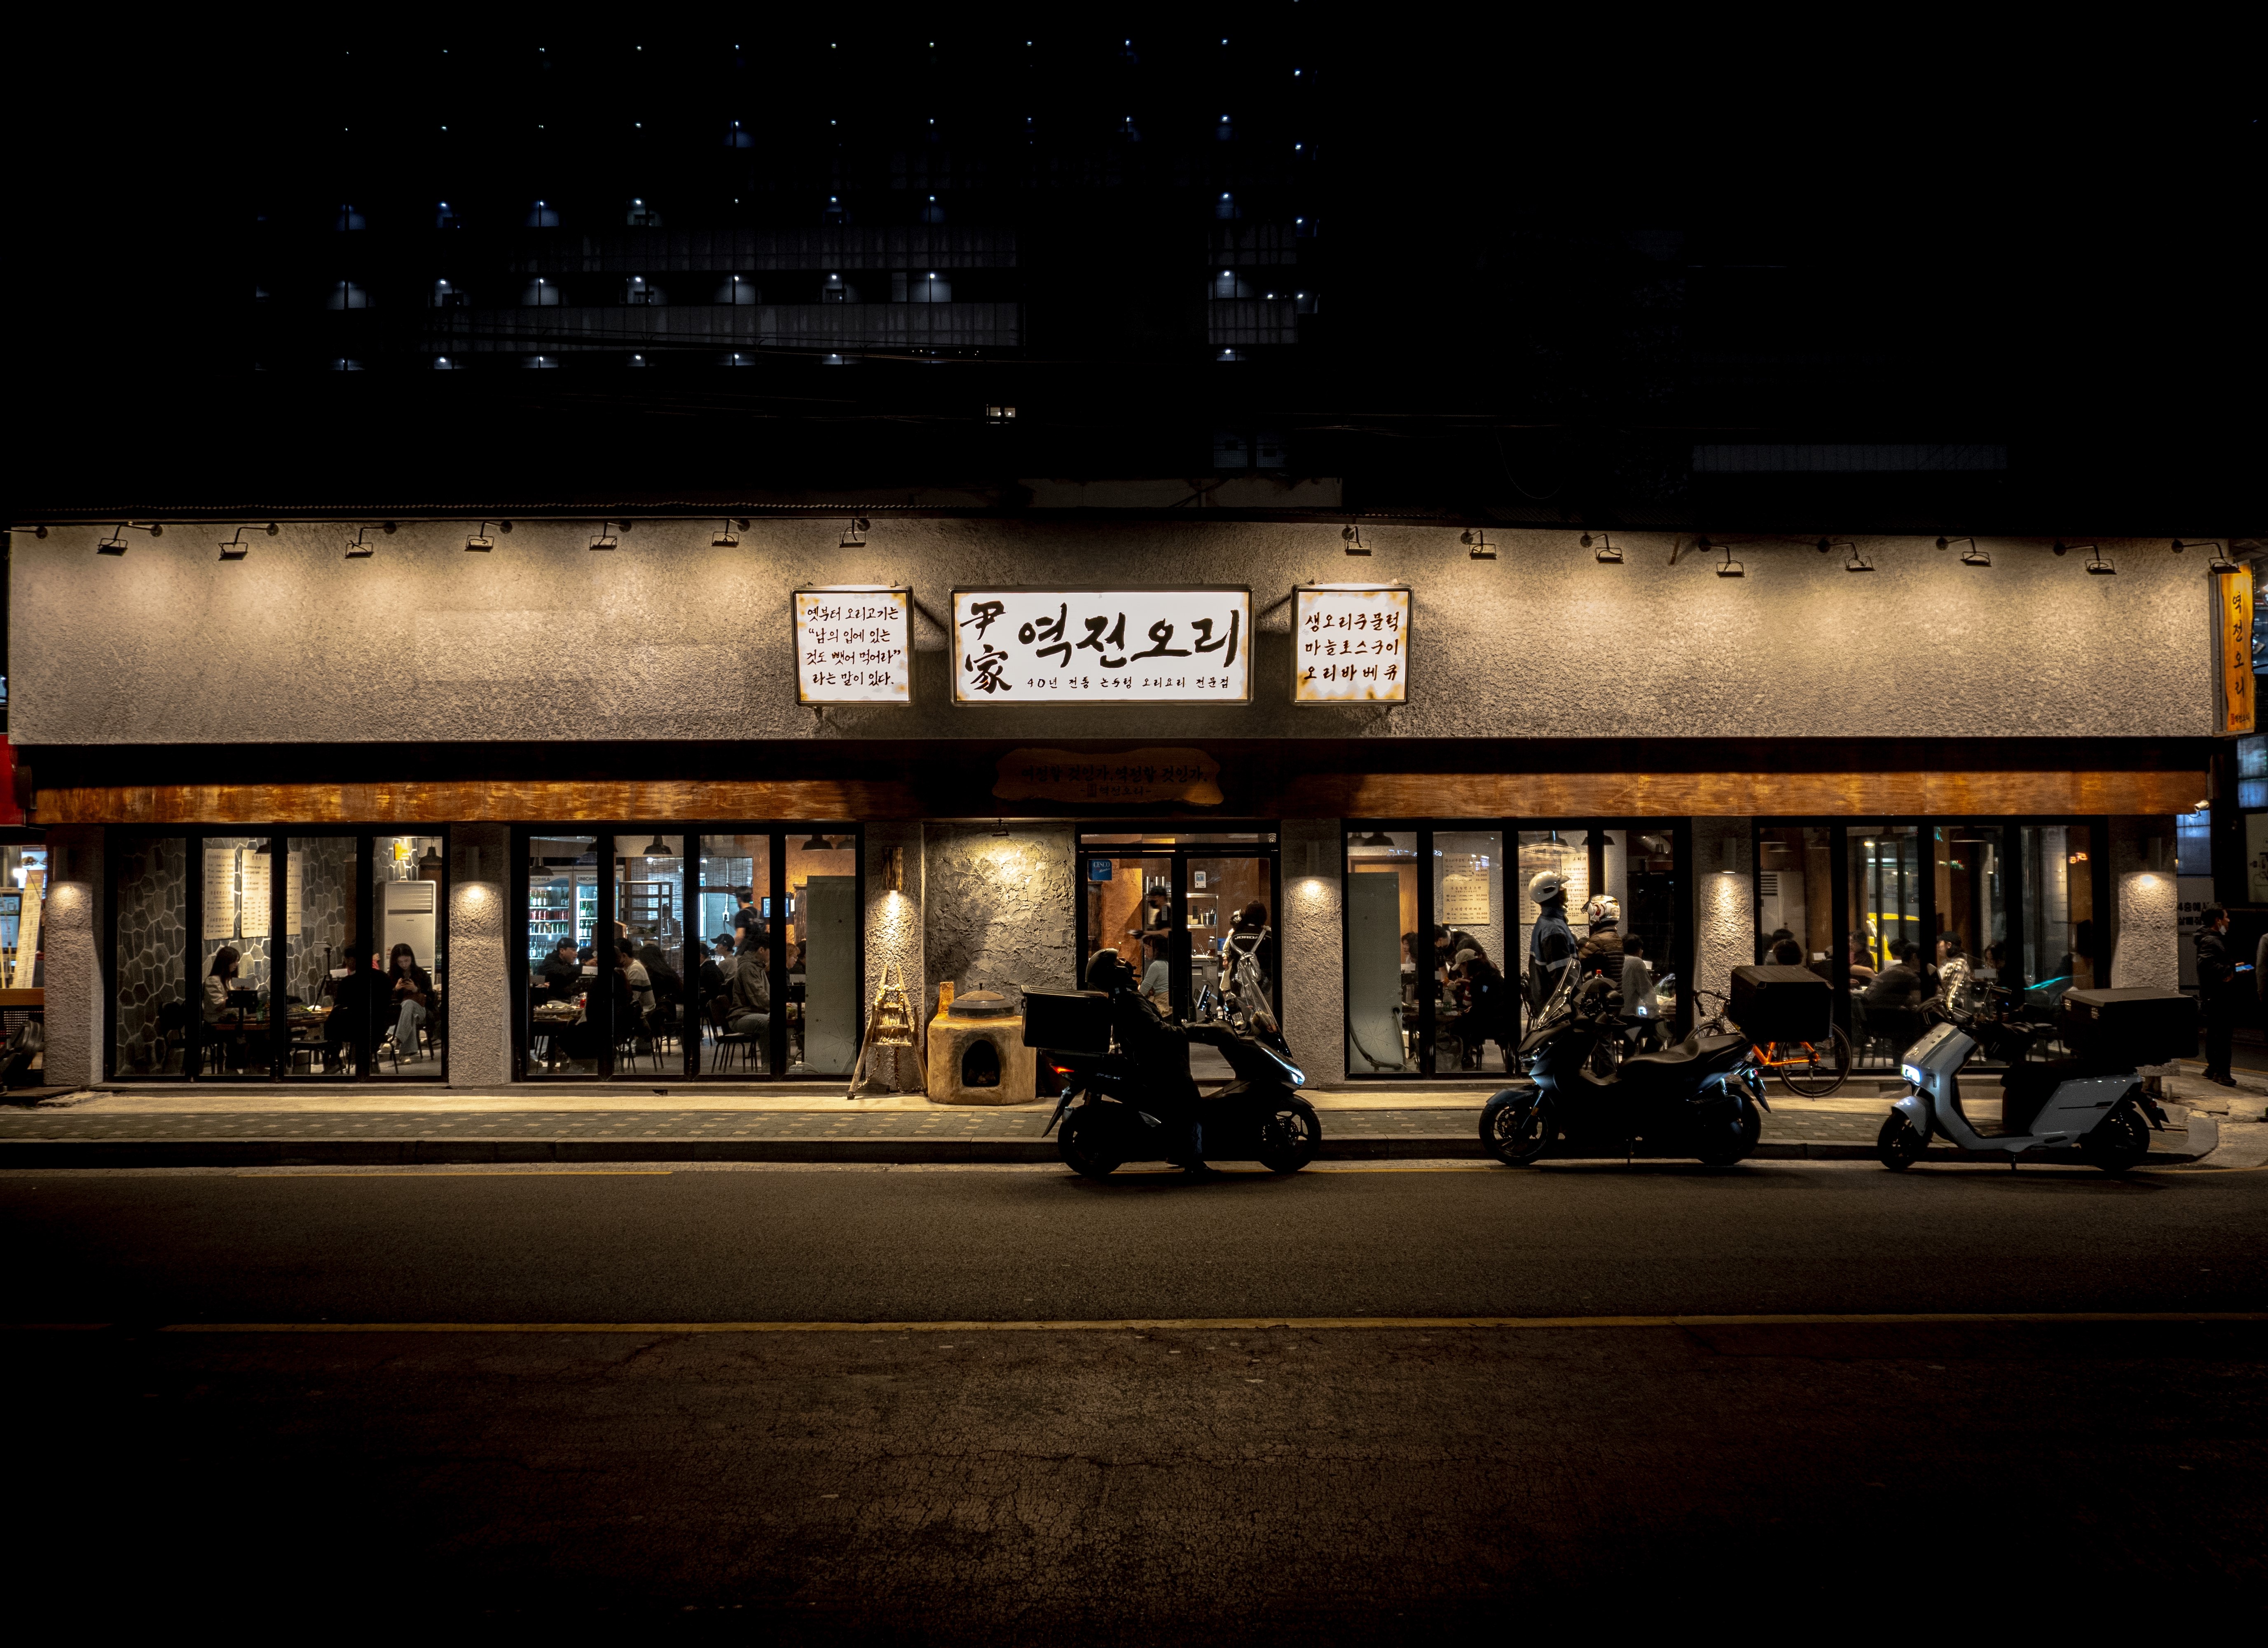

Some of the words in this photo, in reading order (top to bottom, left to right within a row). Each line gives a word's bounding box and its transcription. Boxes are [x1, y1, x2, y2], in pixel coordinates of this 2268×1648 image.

[808, 606, 840, 621] 옛부터
[845, 606, 898, 620] 오리고기는
[1305, 612, 1399, 632] 생오리주물럭
[1018, 602, 1239, 668] 역전오리
[1306, 639, 1398, 655] 마늘로스구이
[2232, 591, 2244, 698] 역전오리
[813, 672, 836, 685] 라는
[841, 671, 863, 686] 말이
[869, 671, 894, 686] 있다.
[1303, 665, 1397, 682] 오리바베큐
[1028, 677, 1057, 688] 40년
[1069, 677, 1089, 688] 전통
[1100, 677, 1131, 688] 논두렁
[1142, 677, 1184, 687] 오리요리
[1196, 677, 1228, 688] 전문점
